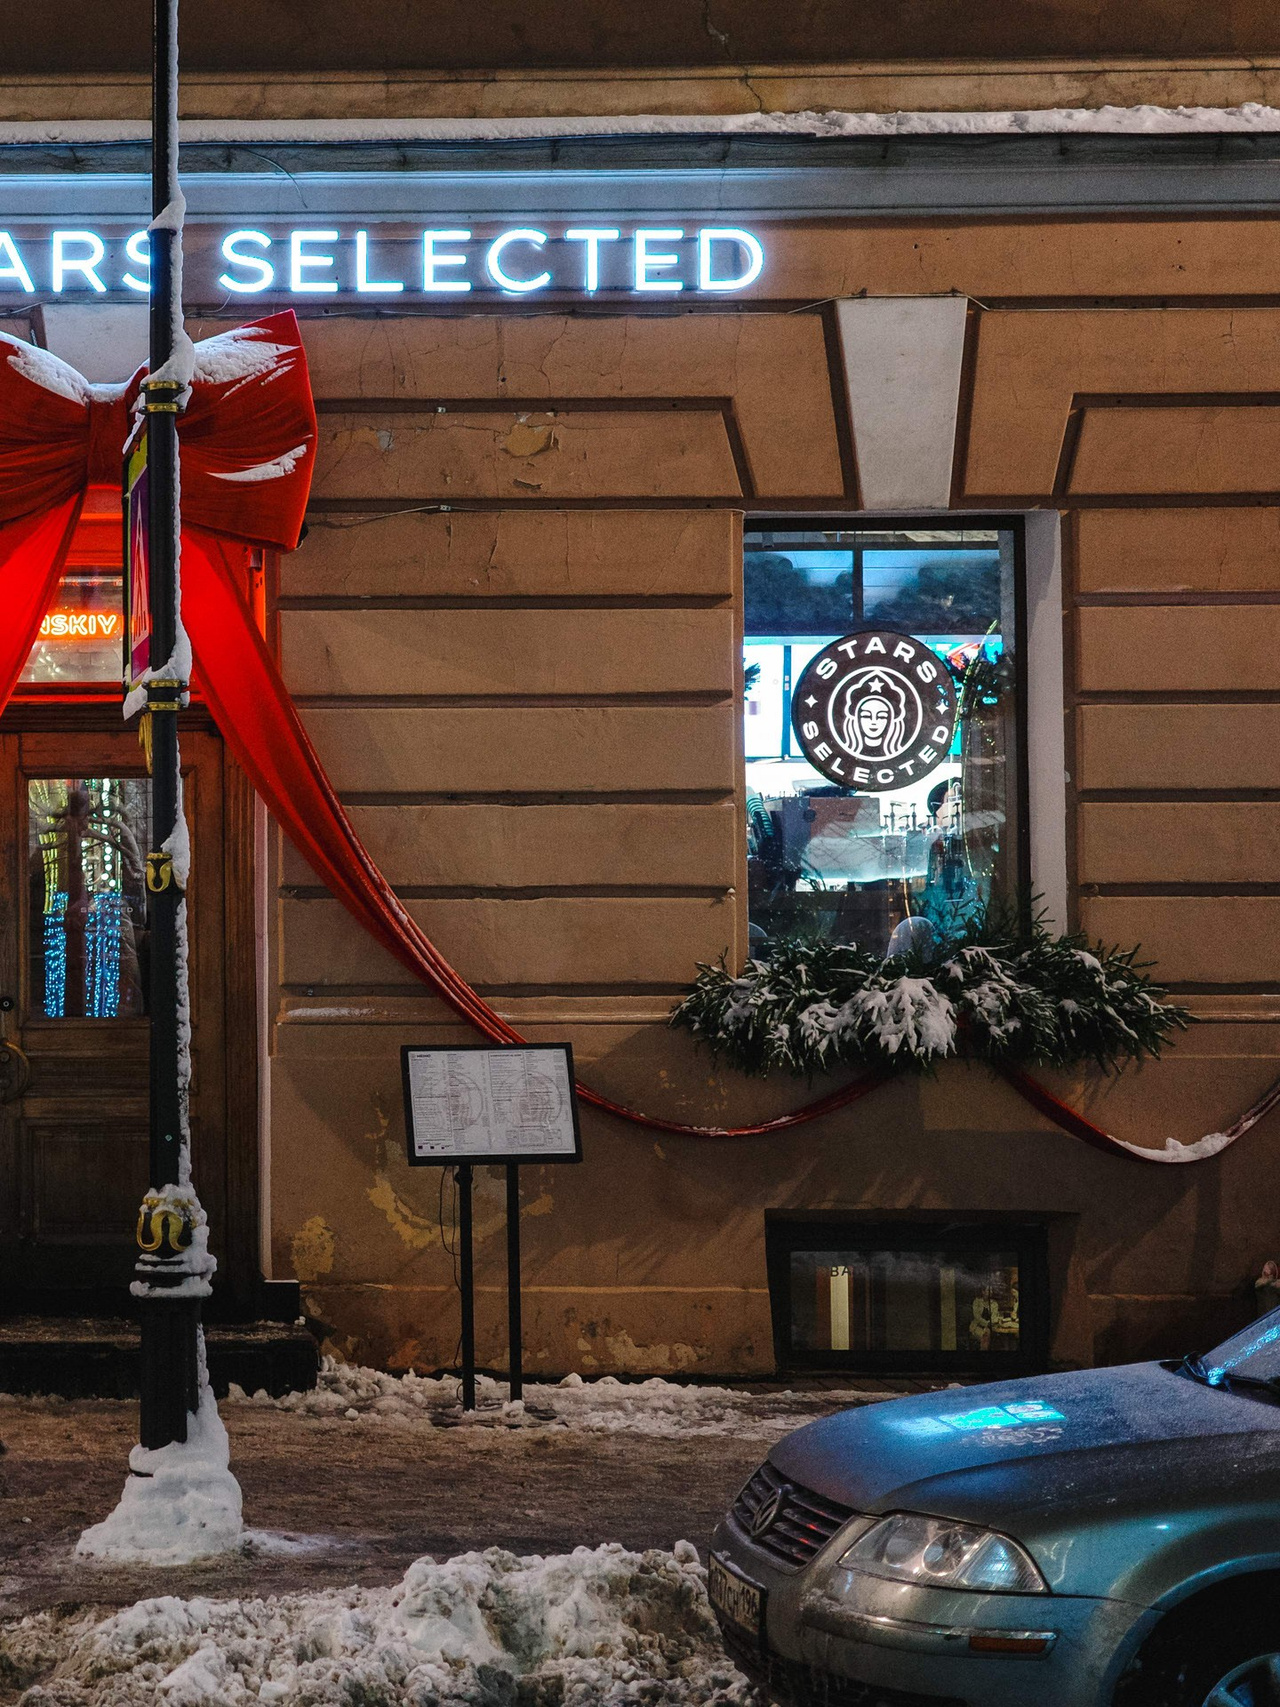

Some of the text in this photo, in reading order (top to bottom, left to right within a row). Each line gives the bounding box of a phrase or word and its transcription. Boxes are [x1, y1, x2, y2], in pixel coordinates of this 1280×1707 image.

[218, 228, 766, 294] SELECTED
[815, 636, 938, 684] STARS
[802, 720, 949, 784] SELECTED
